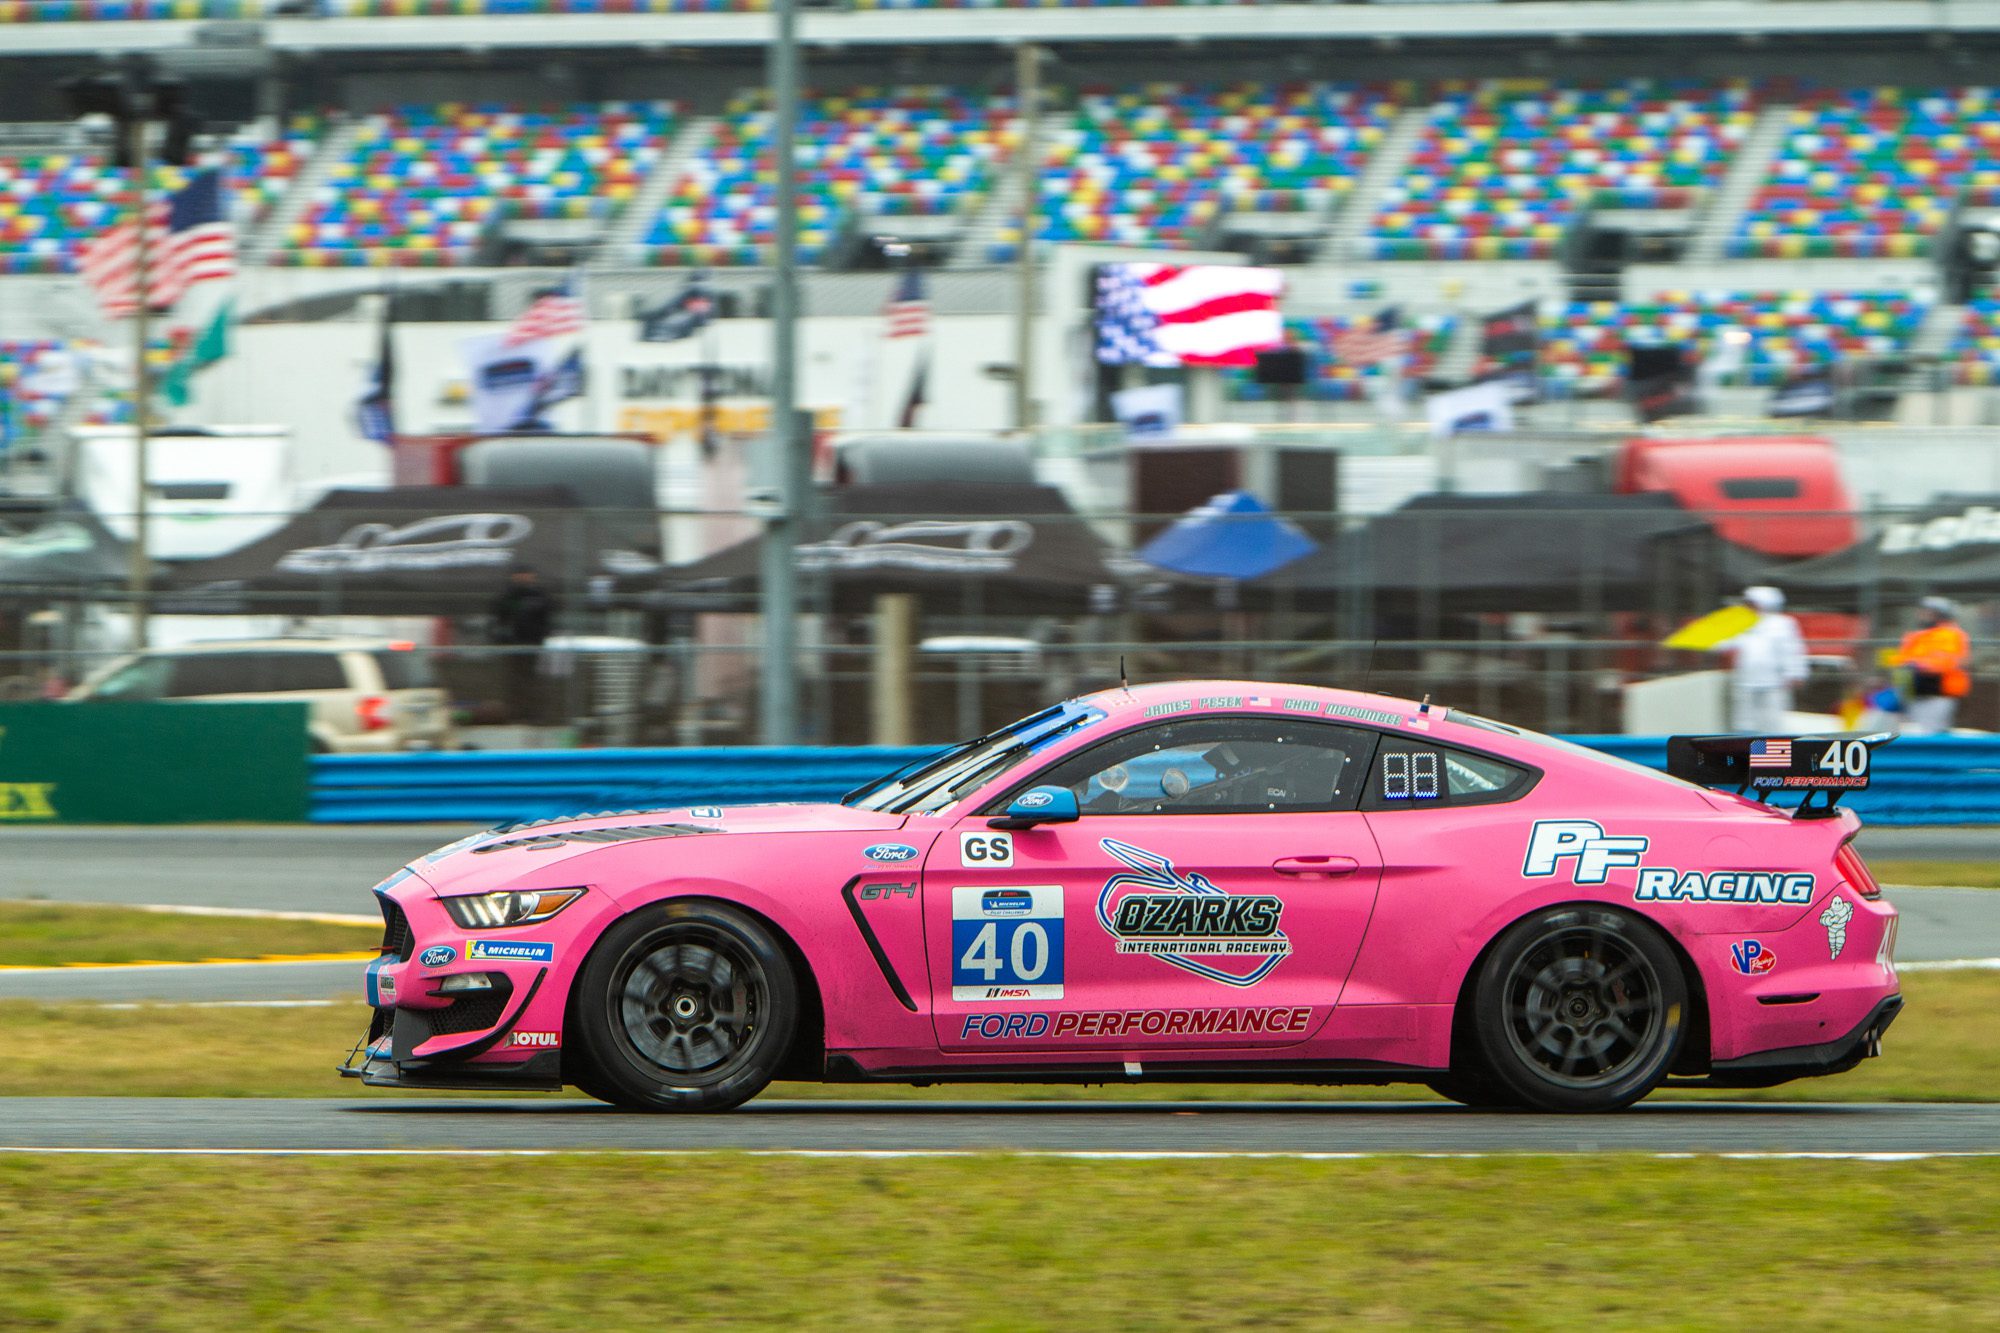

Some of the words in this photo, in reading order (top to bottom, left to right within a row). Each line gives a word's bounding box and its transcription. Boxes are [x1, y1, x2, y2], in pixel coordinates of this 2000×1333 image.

[1144, 699, 1192, 717] JAMES
[1819, 740, 1868, 776] 40
[1753, 777, 1783, 787] FORD
[1783, 776, 1868, 787] PERFORMANCE
[1021, 793, 1047, 806] Ford
[872, 846, 909, 860] Ford
[964, 837, 1010, 861] GS
[1522, 819, 1649, 884] PF
[861, 882, 917, 900] GT4
[1635, 868, 1815, 904] RACING
[1112, 894, 1283, 937] OZARKS
[487, 946, 546, 957] MICHELIN
[961, 922, 1049, 981] 40
[1122, 942, 1222, 953] INTERNATIONAL
[1226, 941, 1288, 953] RACEWAY
[425, 949, 449, 966] Ford
[1731, 939, 1762, 975] VP
[1000, 989, 1031, 997] IMSA
[960, 1014, 1049, 1040] FORD
[1052, 1007, 1312, 1036] PERFORMANCE
